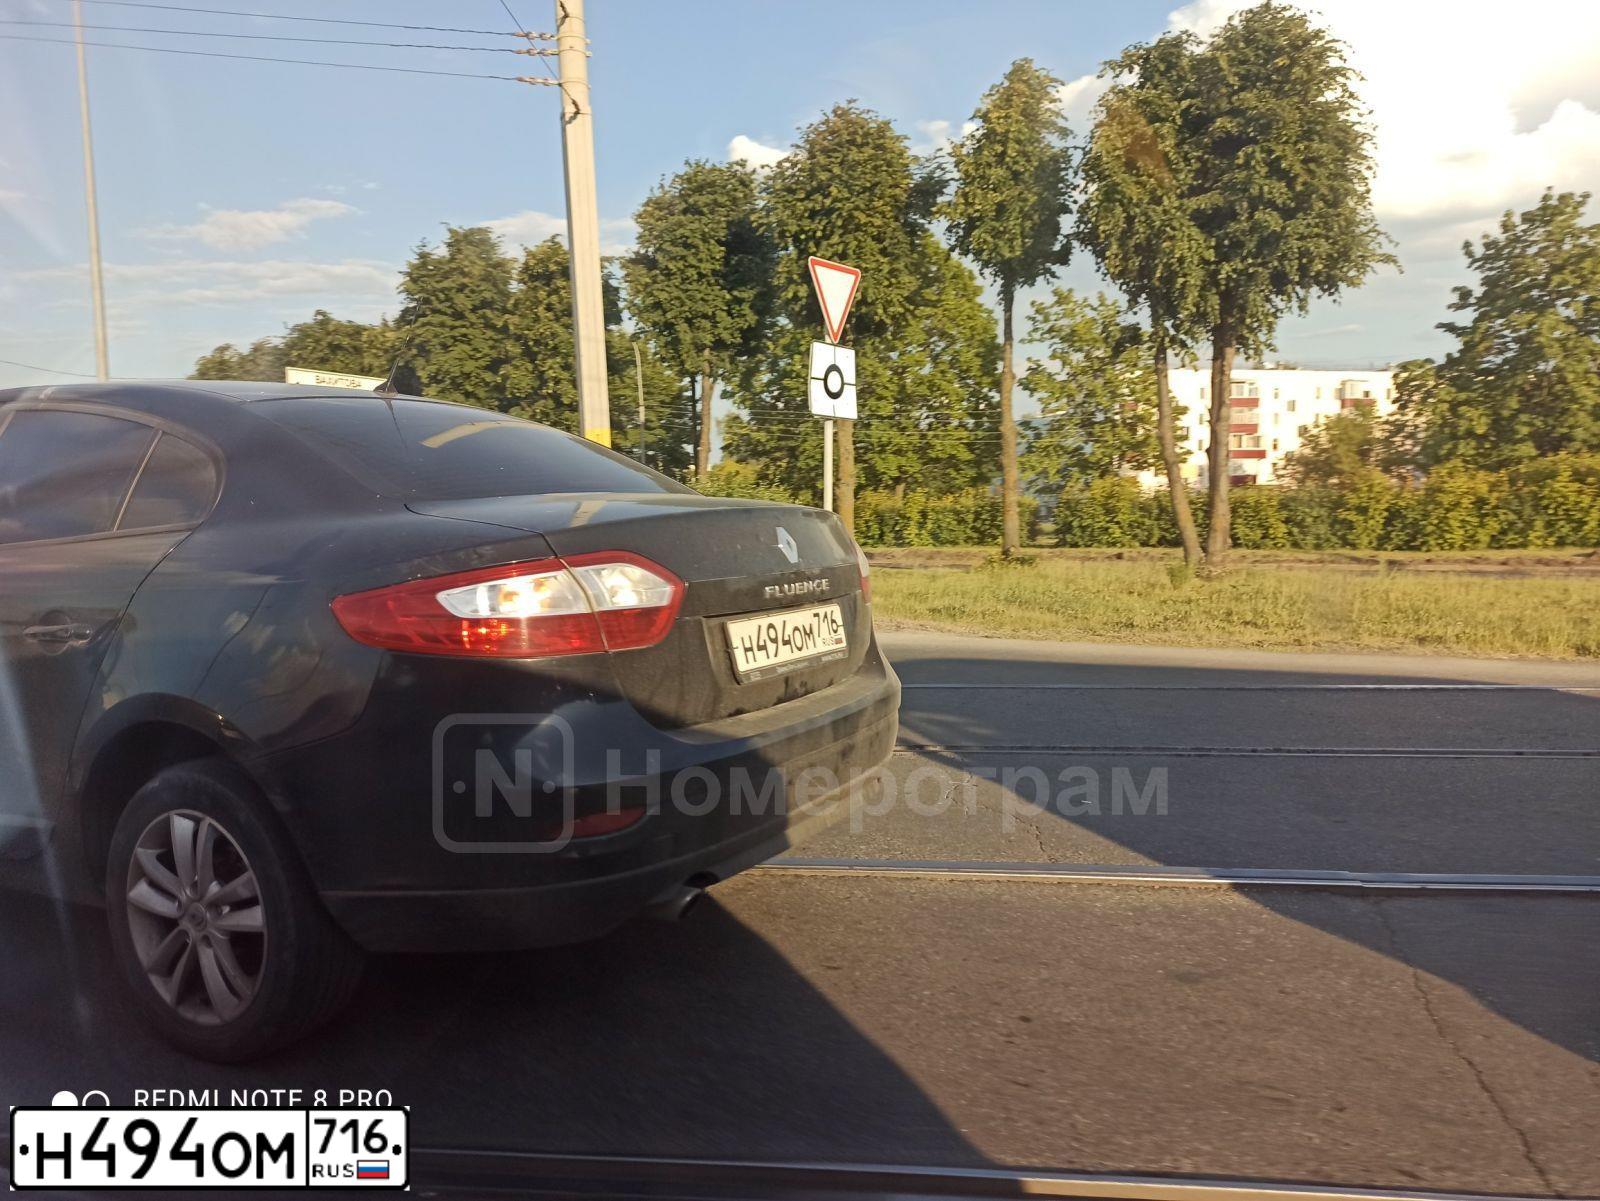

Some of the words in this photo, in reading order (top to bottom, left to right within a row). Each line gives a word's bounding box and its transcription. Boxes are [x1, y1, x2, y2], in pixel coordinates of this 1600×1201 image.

[764, 578, 830, 599] FLUENCE
[741, 620, 817, 665] Н494ОМ
[813, 610, 839, 638] 716
